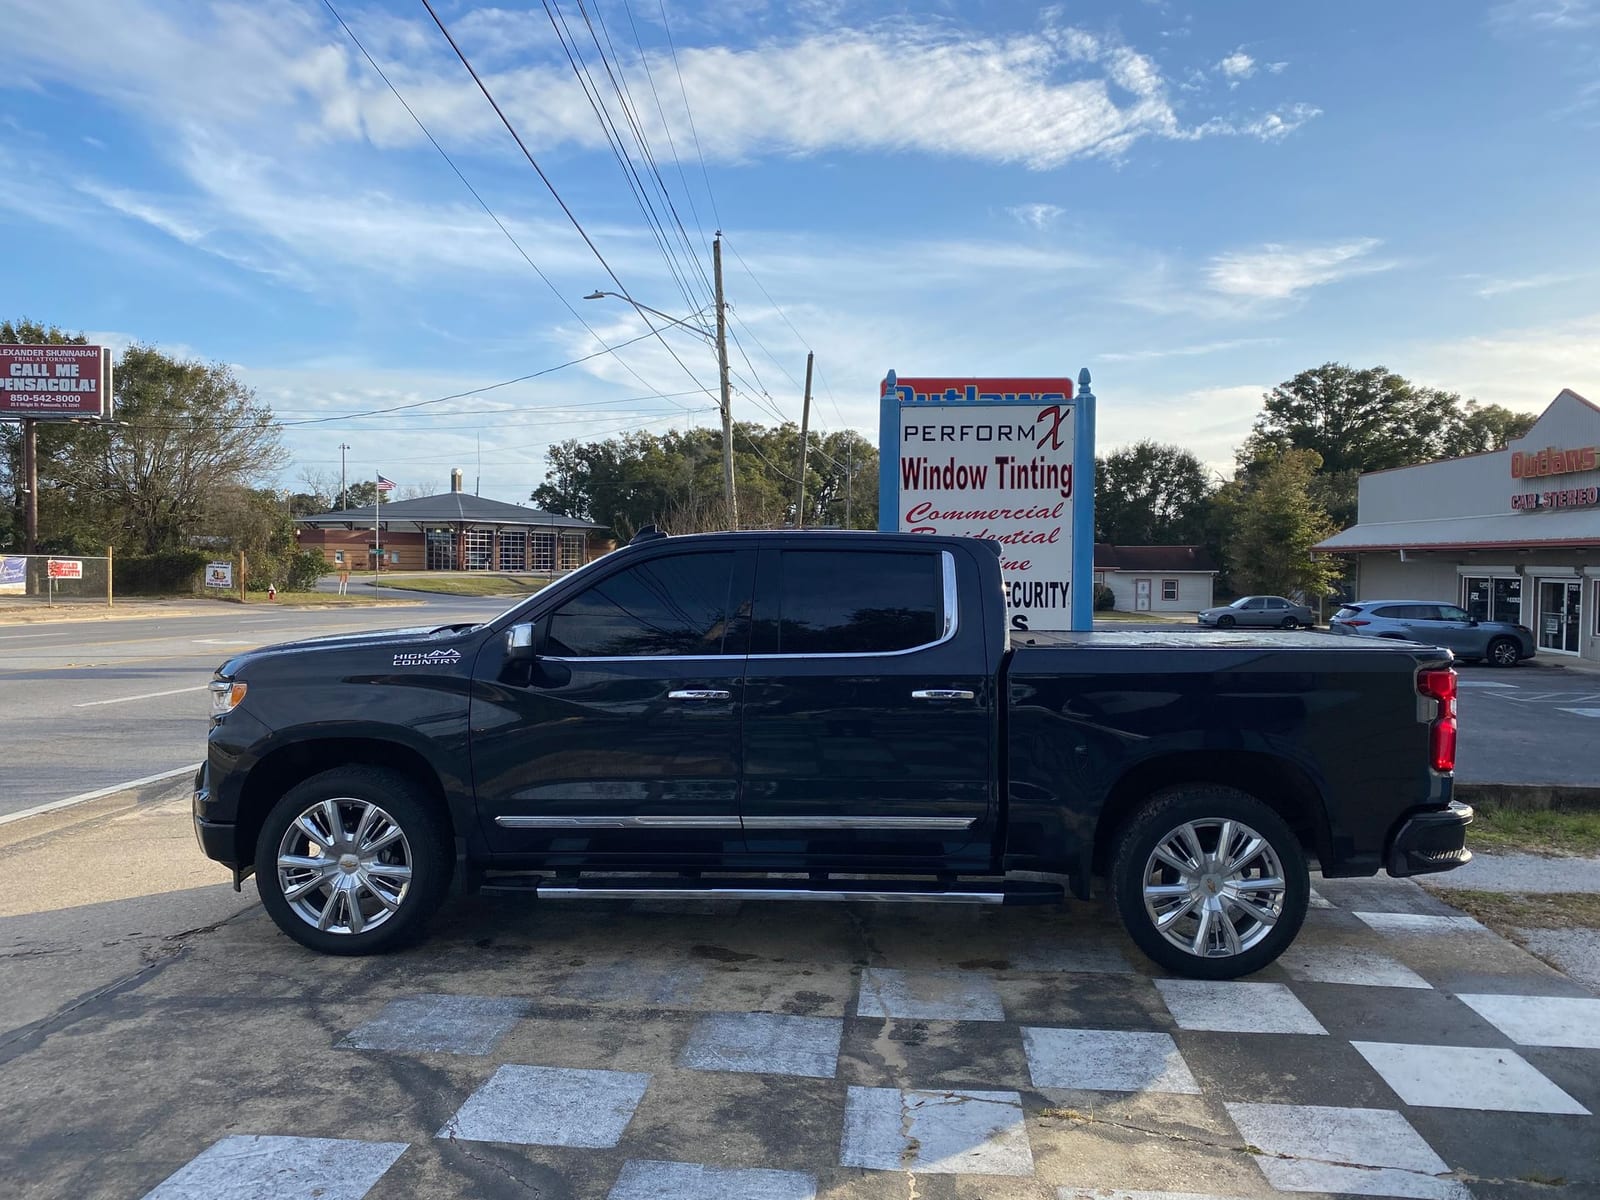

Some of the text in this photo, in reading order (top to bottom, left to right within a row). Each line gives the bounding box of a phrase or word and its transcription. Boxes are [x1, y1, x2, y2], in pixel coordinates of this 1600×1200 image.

[10, 363, 79, 377] CALL ME
[10, 394, 81, 403] 850-542-8000
[902, 456, 1073, 498] Window Tinting
[1511, 487, 1598, 510] CAR STEREO
[906, 502, 1064, 524] Commercial
[1004, 582, 1069, 609] ECURITY
